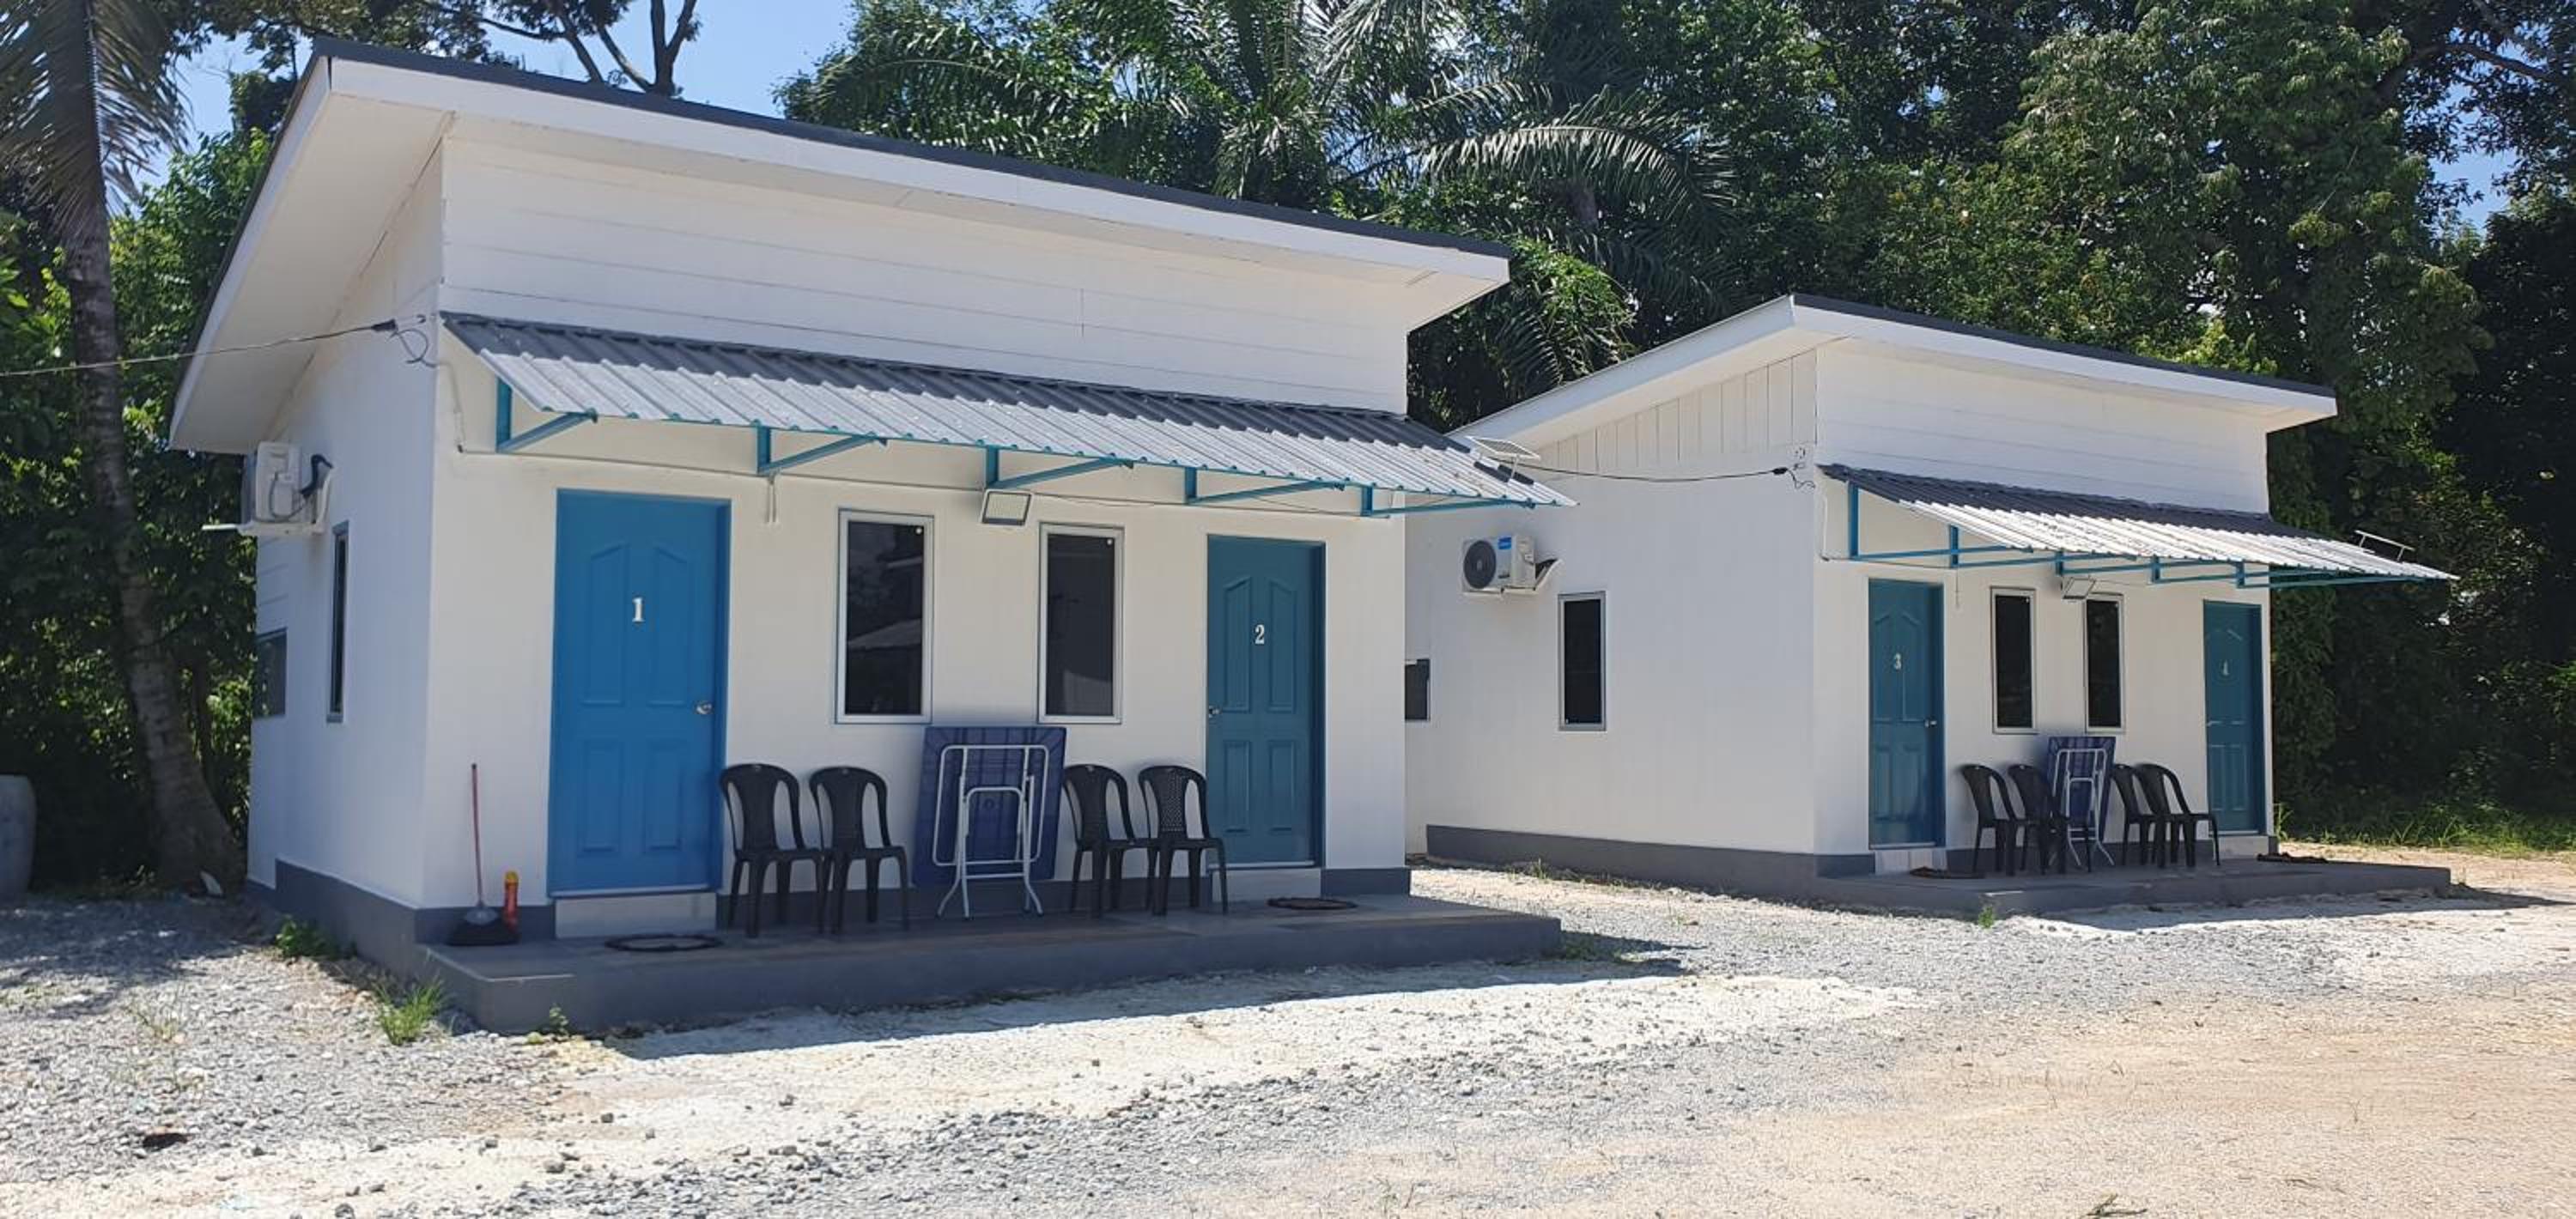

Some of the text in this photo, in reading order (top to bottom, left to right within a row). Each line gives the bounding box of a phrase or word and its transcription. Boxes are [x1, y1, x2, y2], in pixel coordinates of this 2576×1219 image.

[632, 597, 645, 622] 1
[1255, 624, 1265, 645] 2
[1893, 652, 1902, 670] 3
